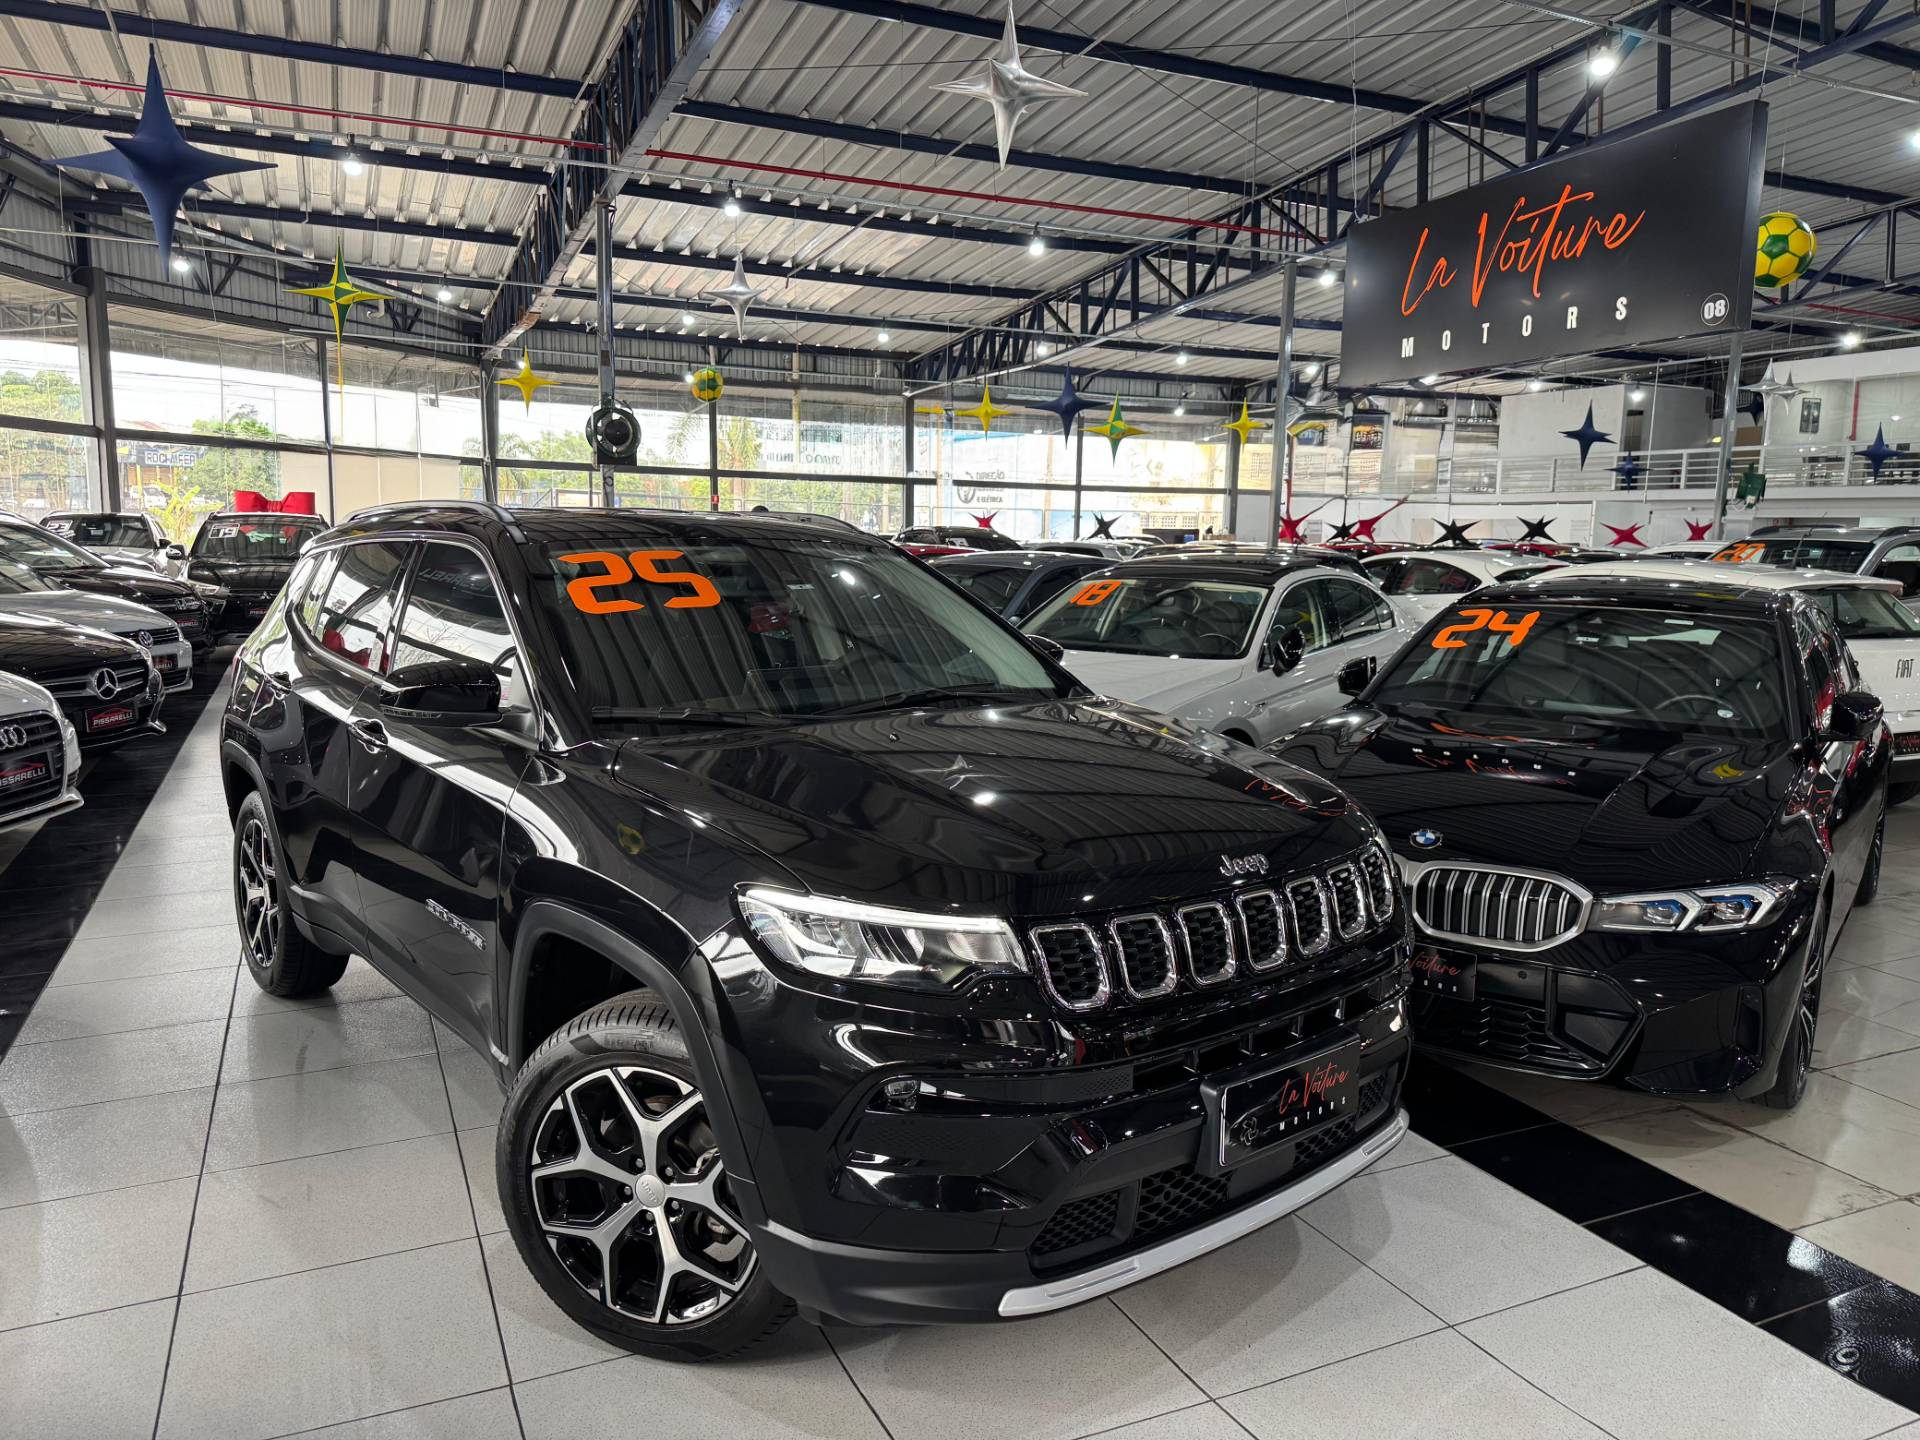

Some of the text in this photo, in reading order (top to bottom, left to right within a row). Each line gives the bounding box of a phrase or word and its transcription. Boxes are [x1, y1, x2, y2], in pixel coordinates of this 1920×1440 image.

[1401, 184, 1646, 317] La Voiture
[1401, 296, 1628, 358] MOTORS
[1703, 302, 1727, 320] 08
[557, 550, 721, 614] 25
[1070, 580, 1122, 606] 18
[1432, 609, 1541, 648] 24
[1895, 658, 1915, 679] FIAT
[93, 711, 132, 727] PISSARELLI
[1220, 853, 1269, 877] Jeep
[1279, 1061, 1349, 1115] La Voiture
[1279, 1096, 1346, 1131] MOTORS
